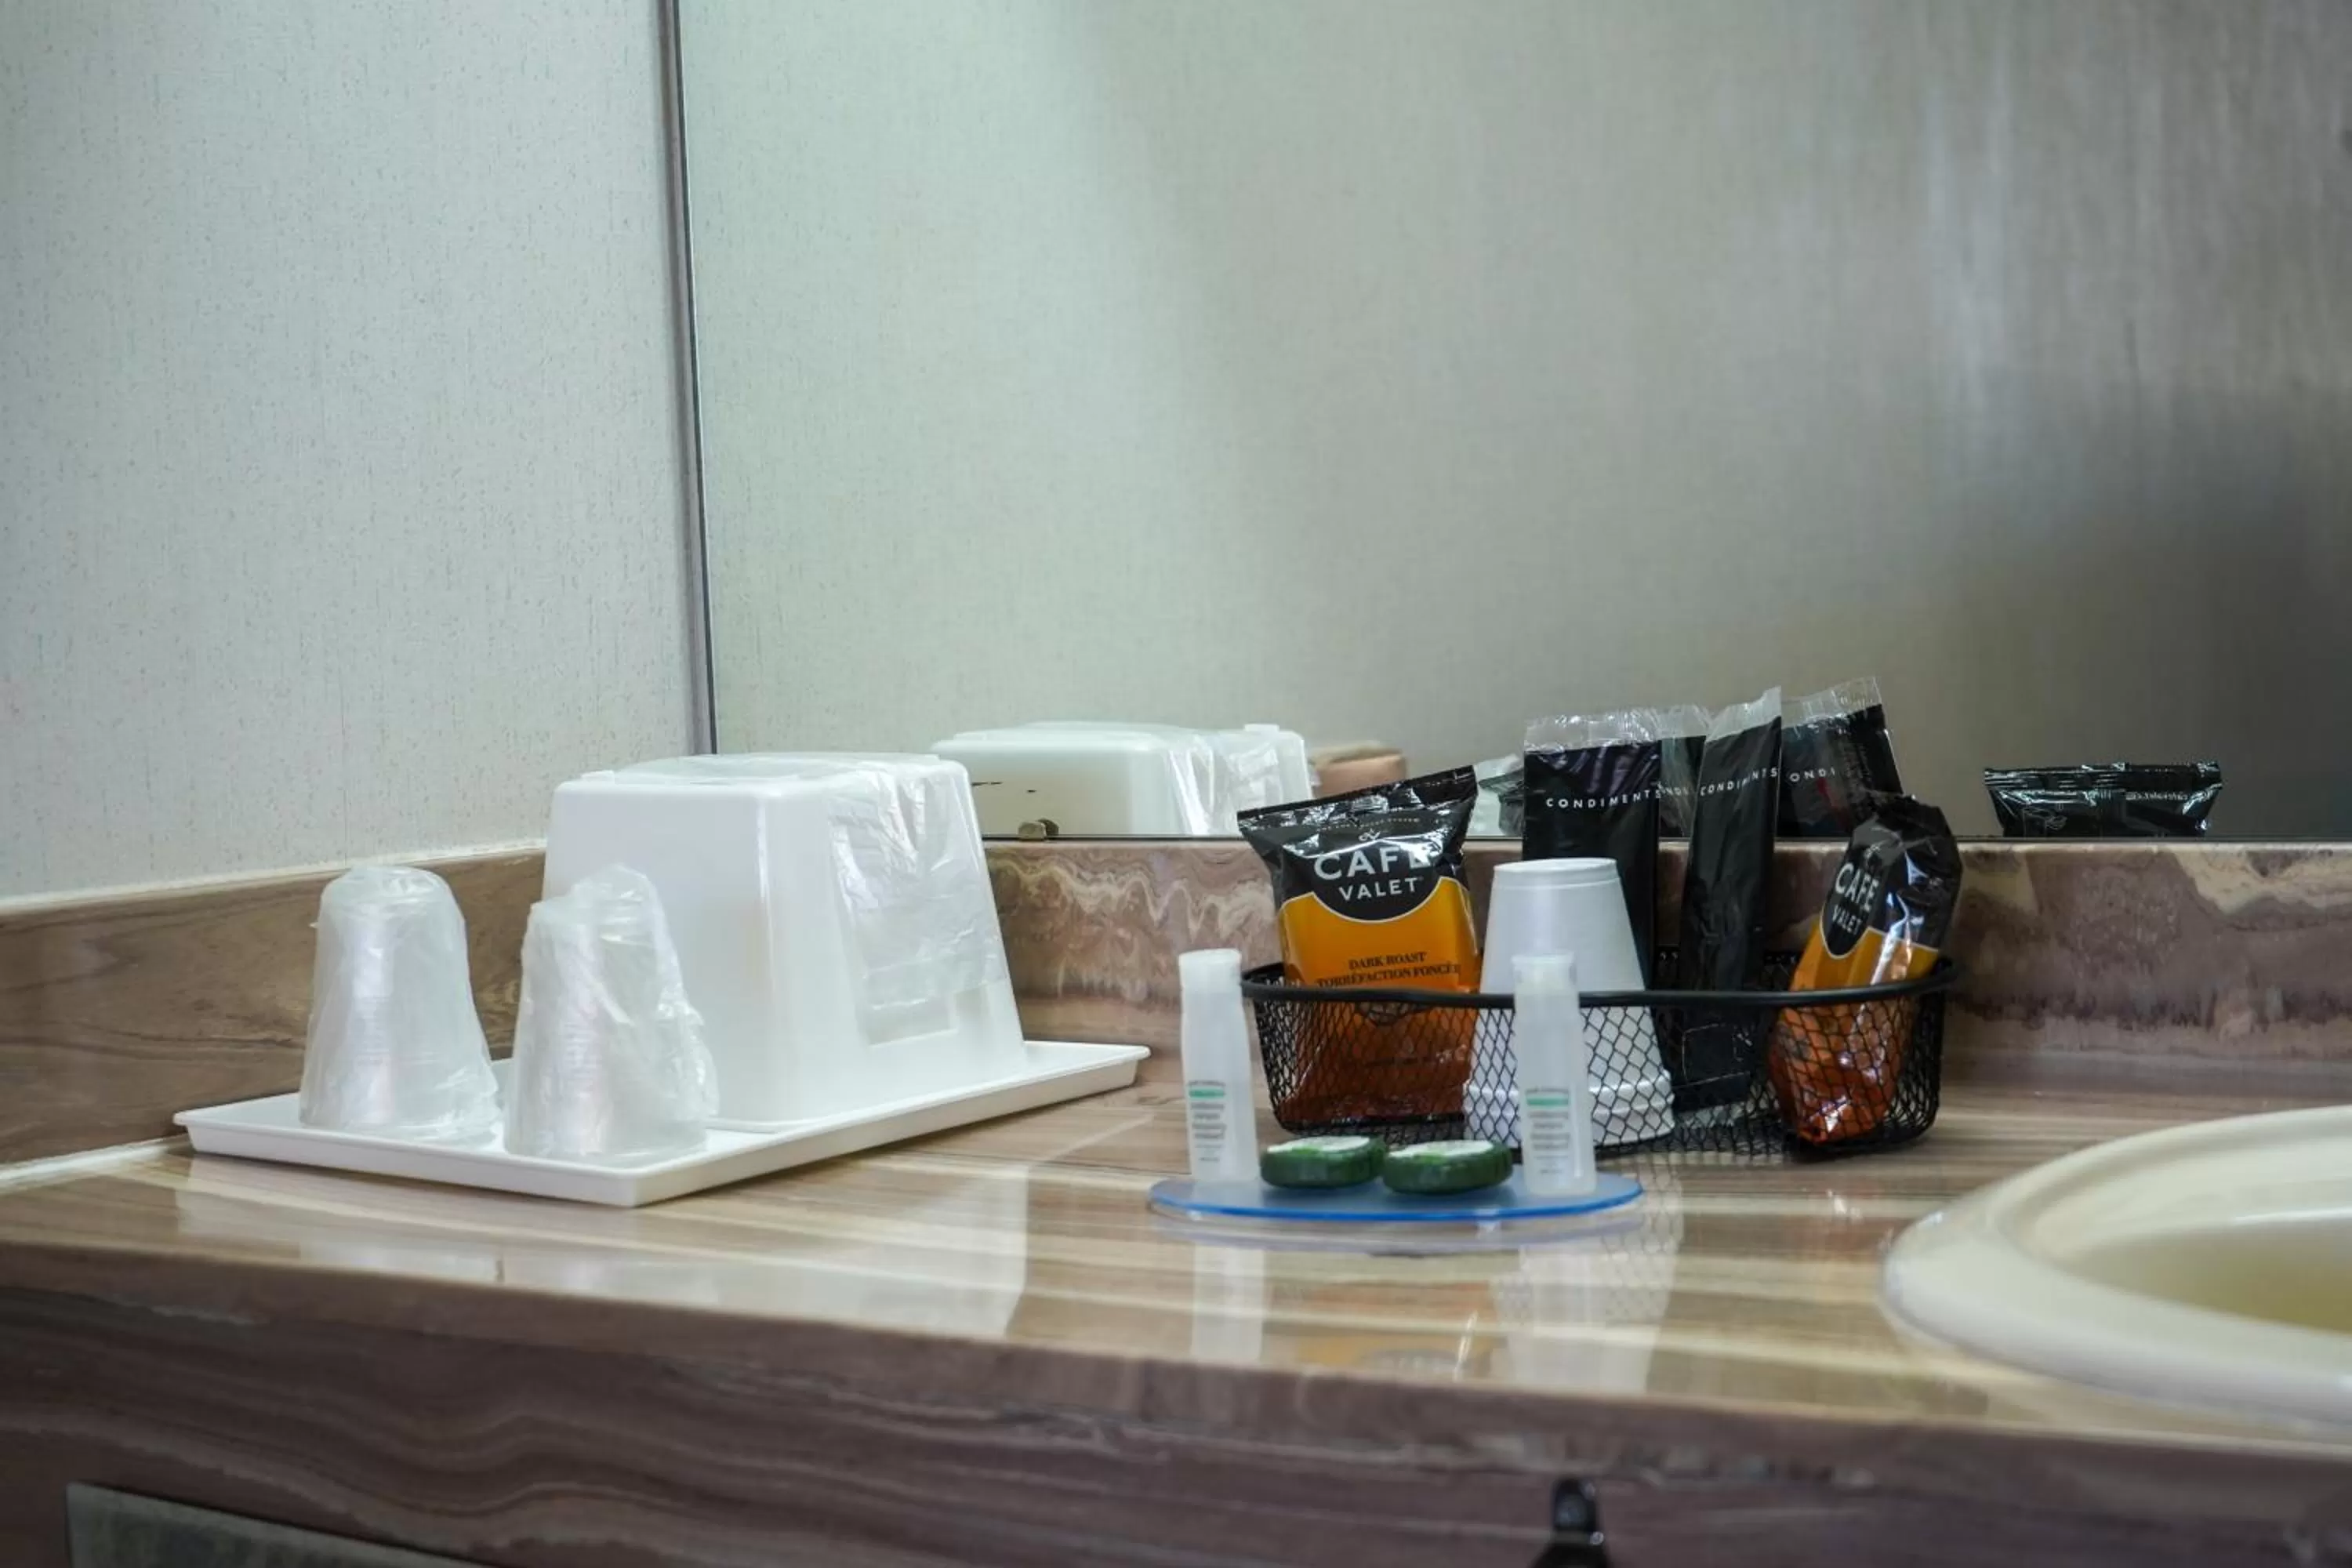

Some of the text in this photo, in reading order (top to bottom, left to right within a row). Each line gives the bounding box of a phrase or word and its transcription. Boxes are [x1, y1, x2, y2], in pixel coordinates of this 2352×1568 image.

[1546, 789, 1661, 809] CONDIMENTS
[1339, 877, 1418, 901] VALET
[1835, 862, 1879, 913] CAFE
[1348, 951, 1428, 970] DARK ROAST
